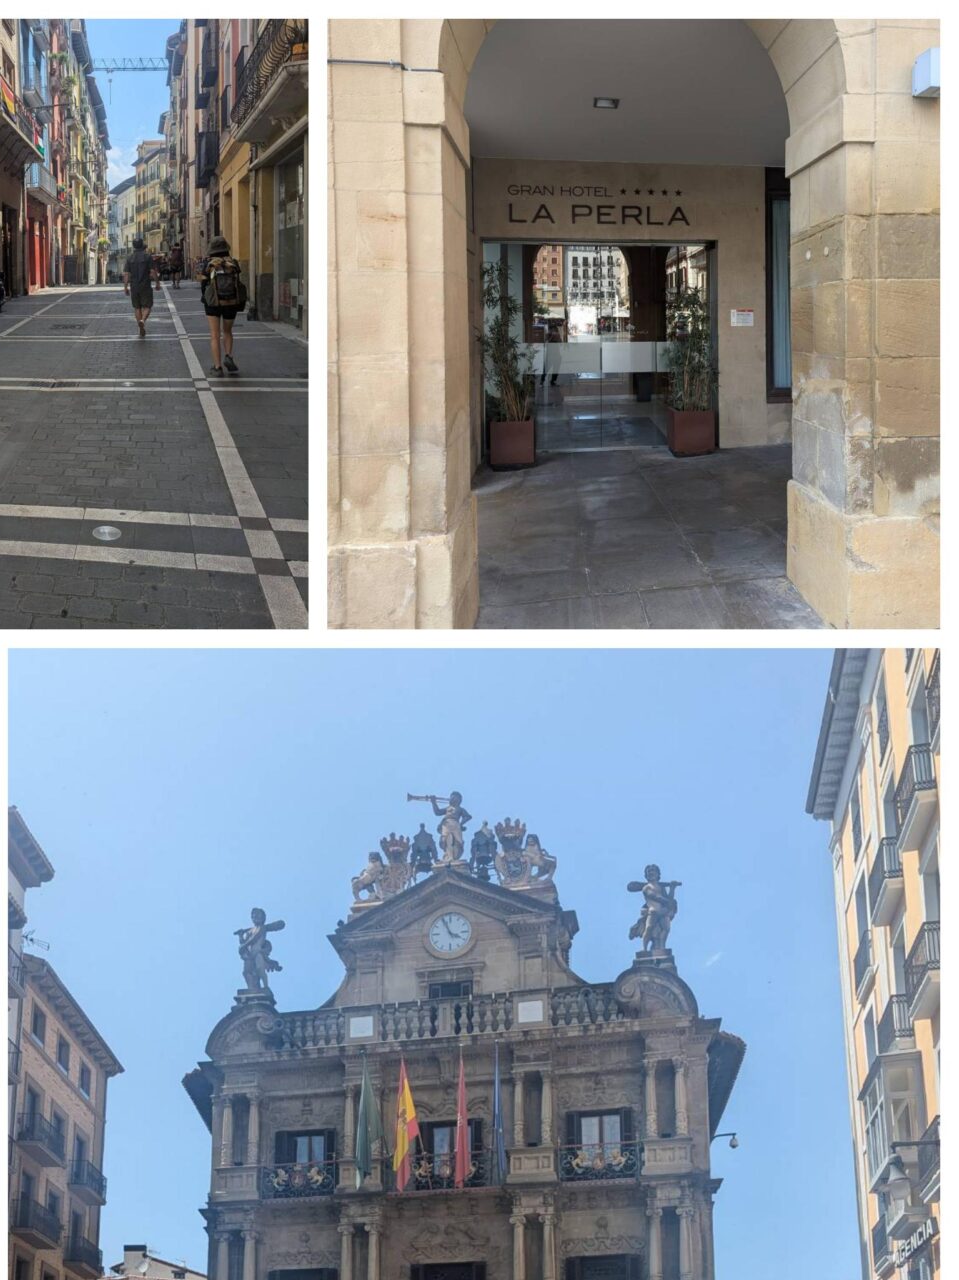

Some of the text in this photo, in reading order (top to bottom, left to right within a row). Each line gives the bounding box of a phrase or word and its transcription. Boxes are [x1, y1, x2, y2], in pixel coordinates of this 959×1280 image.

[507, 184, 613, 197] GRAN HOTEL
[508, 203, 690, 226] LA PERLA
[892, 1218, 934, 1265] AGENCIA
